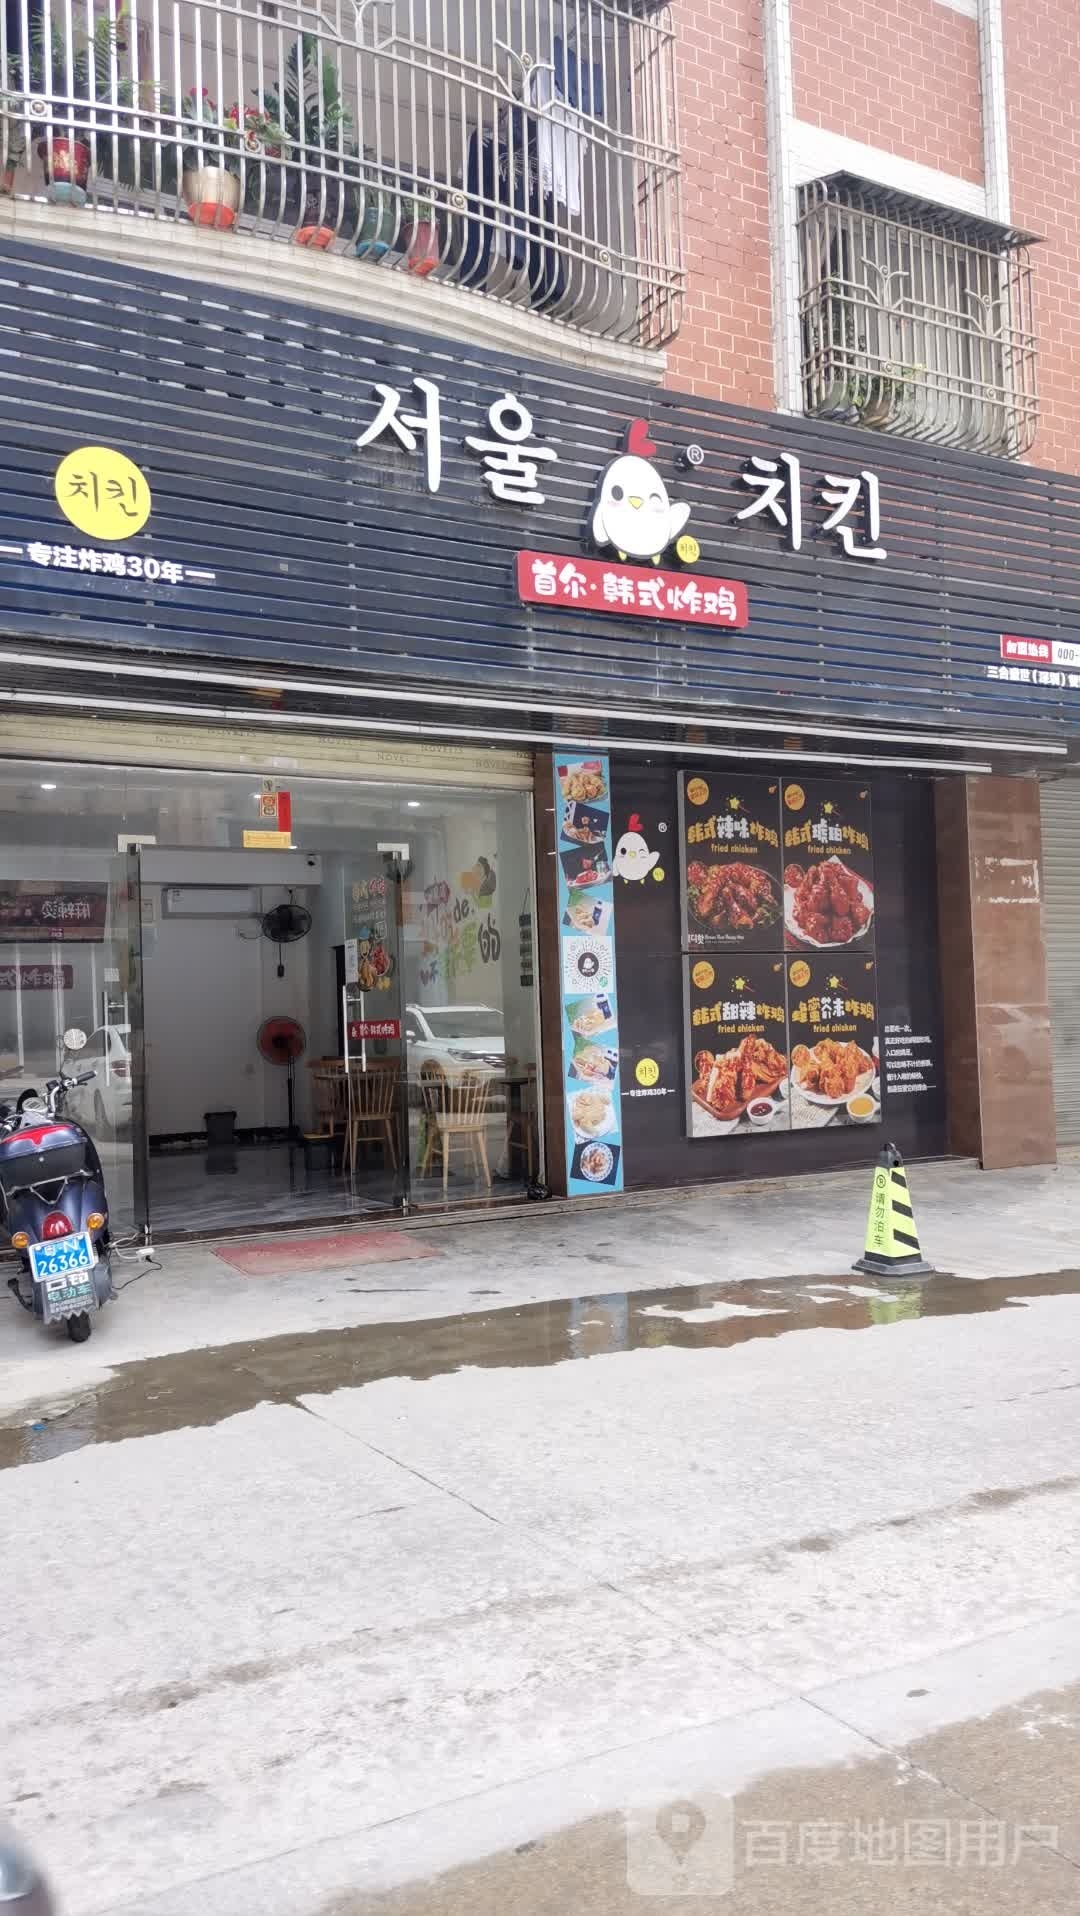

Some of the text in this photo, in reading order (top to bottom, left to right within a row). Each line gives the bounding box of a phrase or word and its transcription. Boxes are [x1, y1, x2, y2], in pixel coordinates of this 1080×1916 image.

[356, 377, 887, 560] 서울 치킨
[63, 470, 139, 518] 치킨
[38, 1249, 88, 1276] 26366
